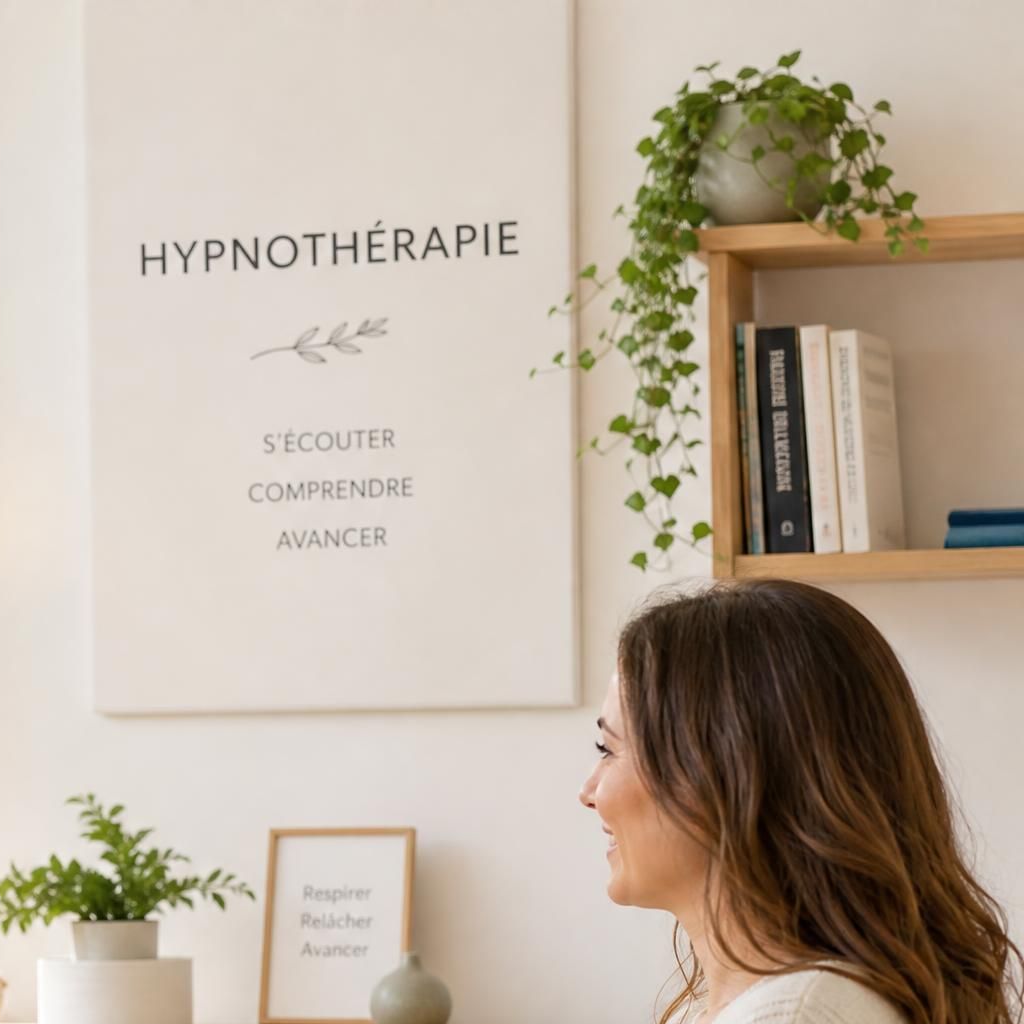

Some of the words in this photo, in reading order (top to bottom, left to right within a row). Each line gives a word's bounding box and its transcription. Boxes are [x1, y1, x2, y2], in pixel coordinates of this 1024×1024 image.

[139, 219, 521, 277] HYPNOTHÉRAPIE
[247, 476, 414, 504] COMPRENDRE
[275, 526, 387, 551] AVANCER
[302, 884, 372, 905] Respirer
[299, 940, 370, 958] Avancer
